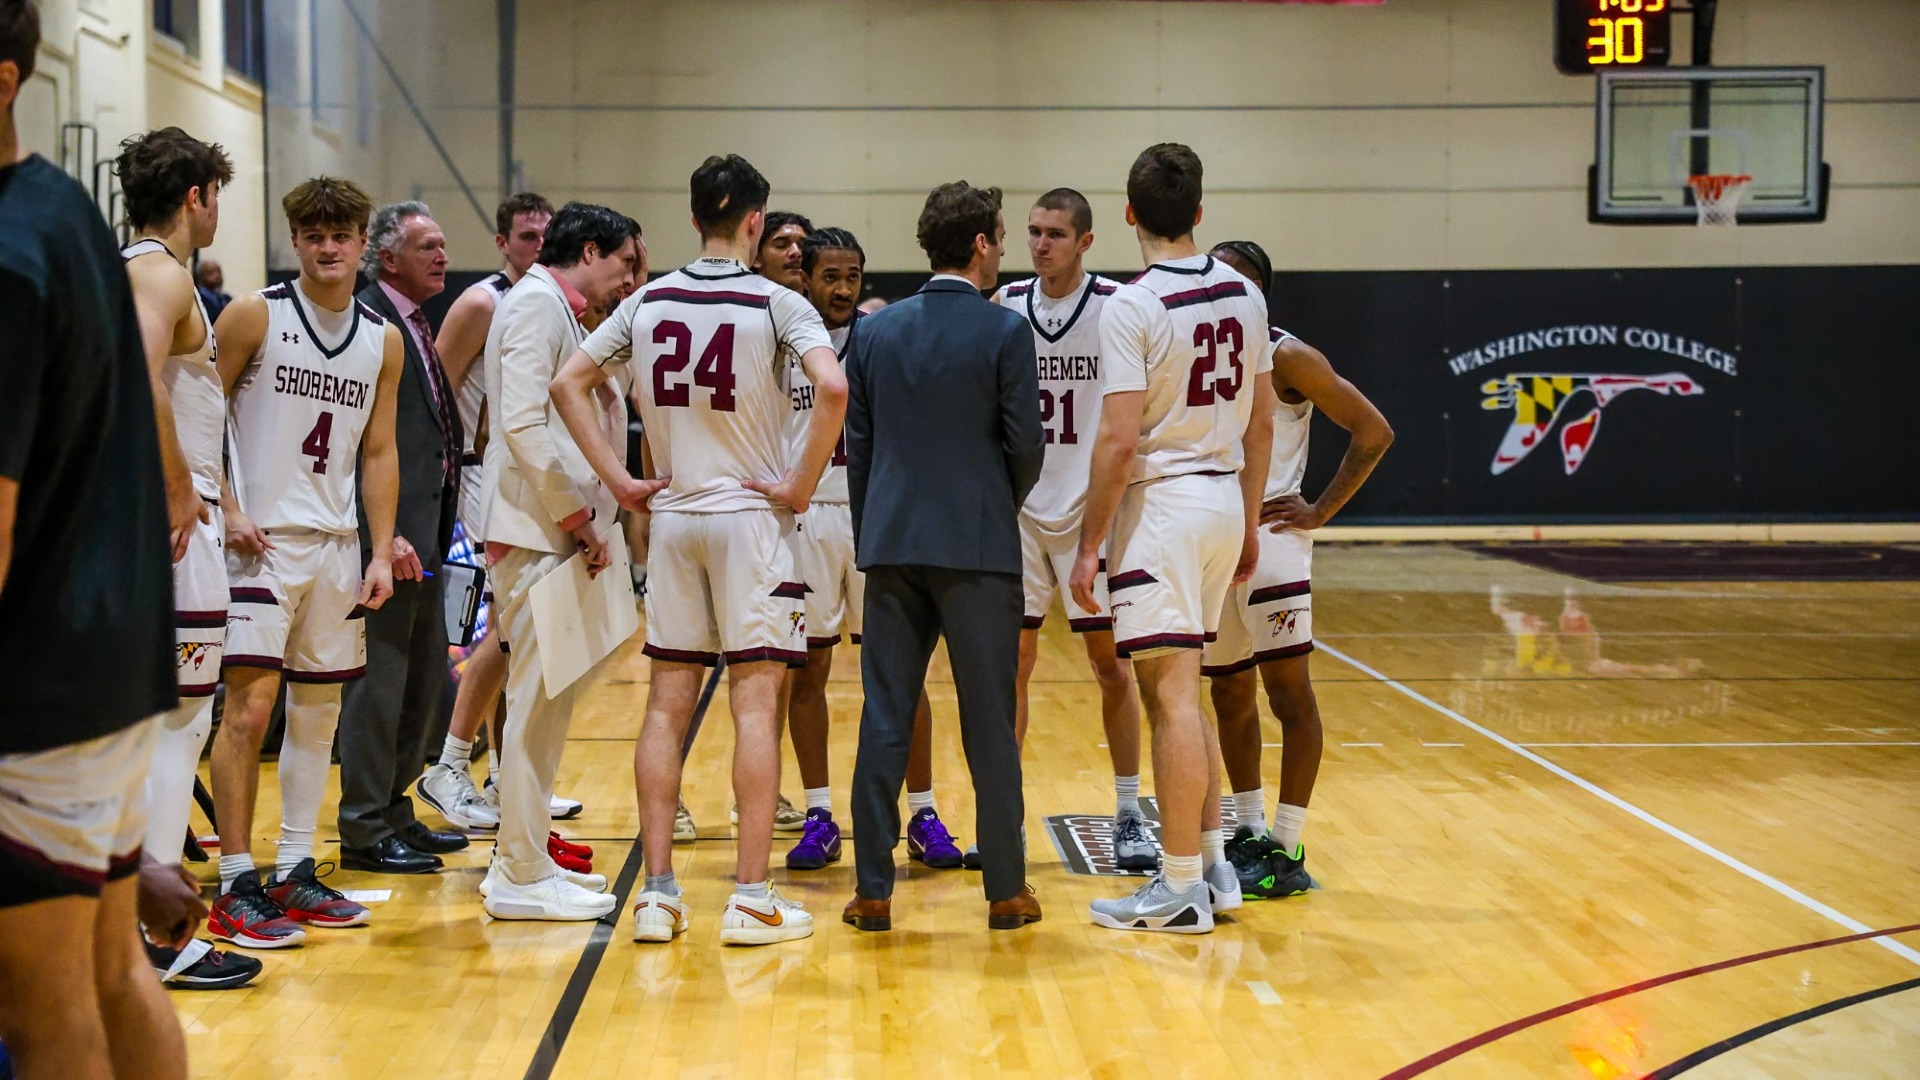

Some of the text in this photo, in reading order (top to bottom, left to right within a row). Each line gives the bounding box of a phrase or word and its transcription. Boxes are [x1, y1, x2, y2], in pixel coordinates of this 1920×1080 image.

[1588, 17, 1643, 64] 30
[652, 319, 736, 412] 24
[1187, 316, 1243, 407] 23
[1448, 325, 1738, 376] WASHINGTON COLLEGE
[275, 364, 369, 410] SHOREMEN
[302, 411, 333, 475] 4
[1038, 389, 1078, 445] 21
